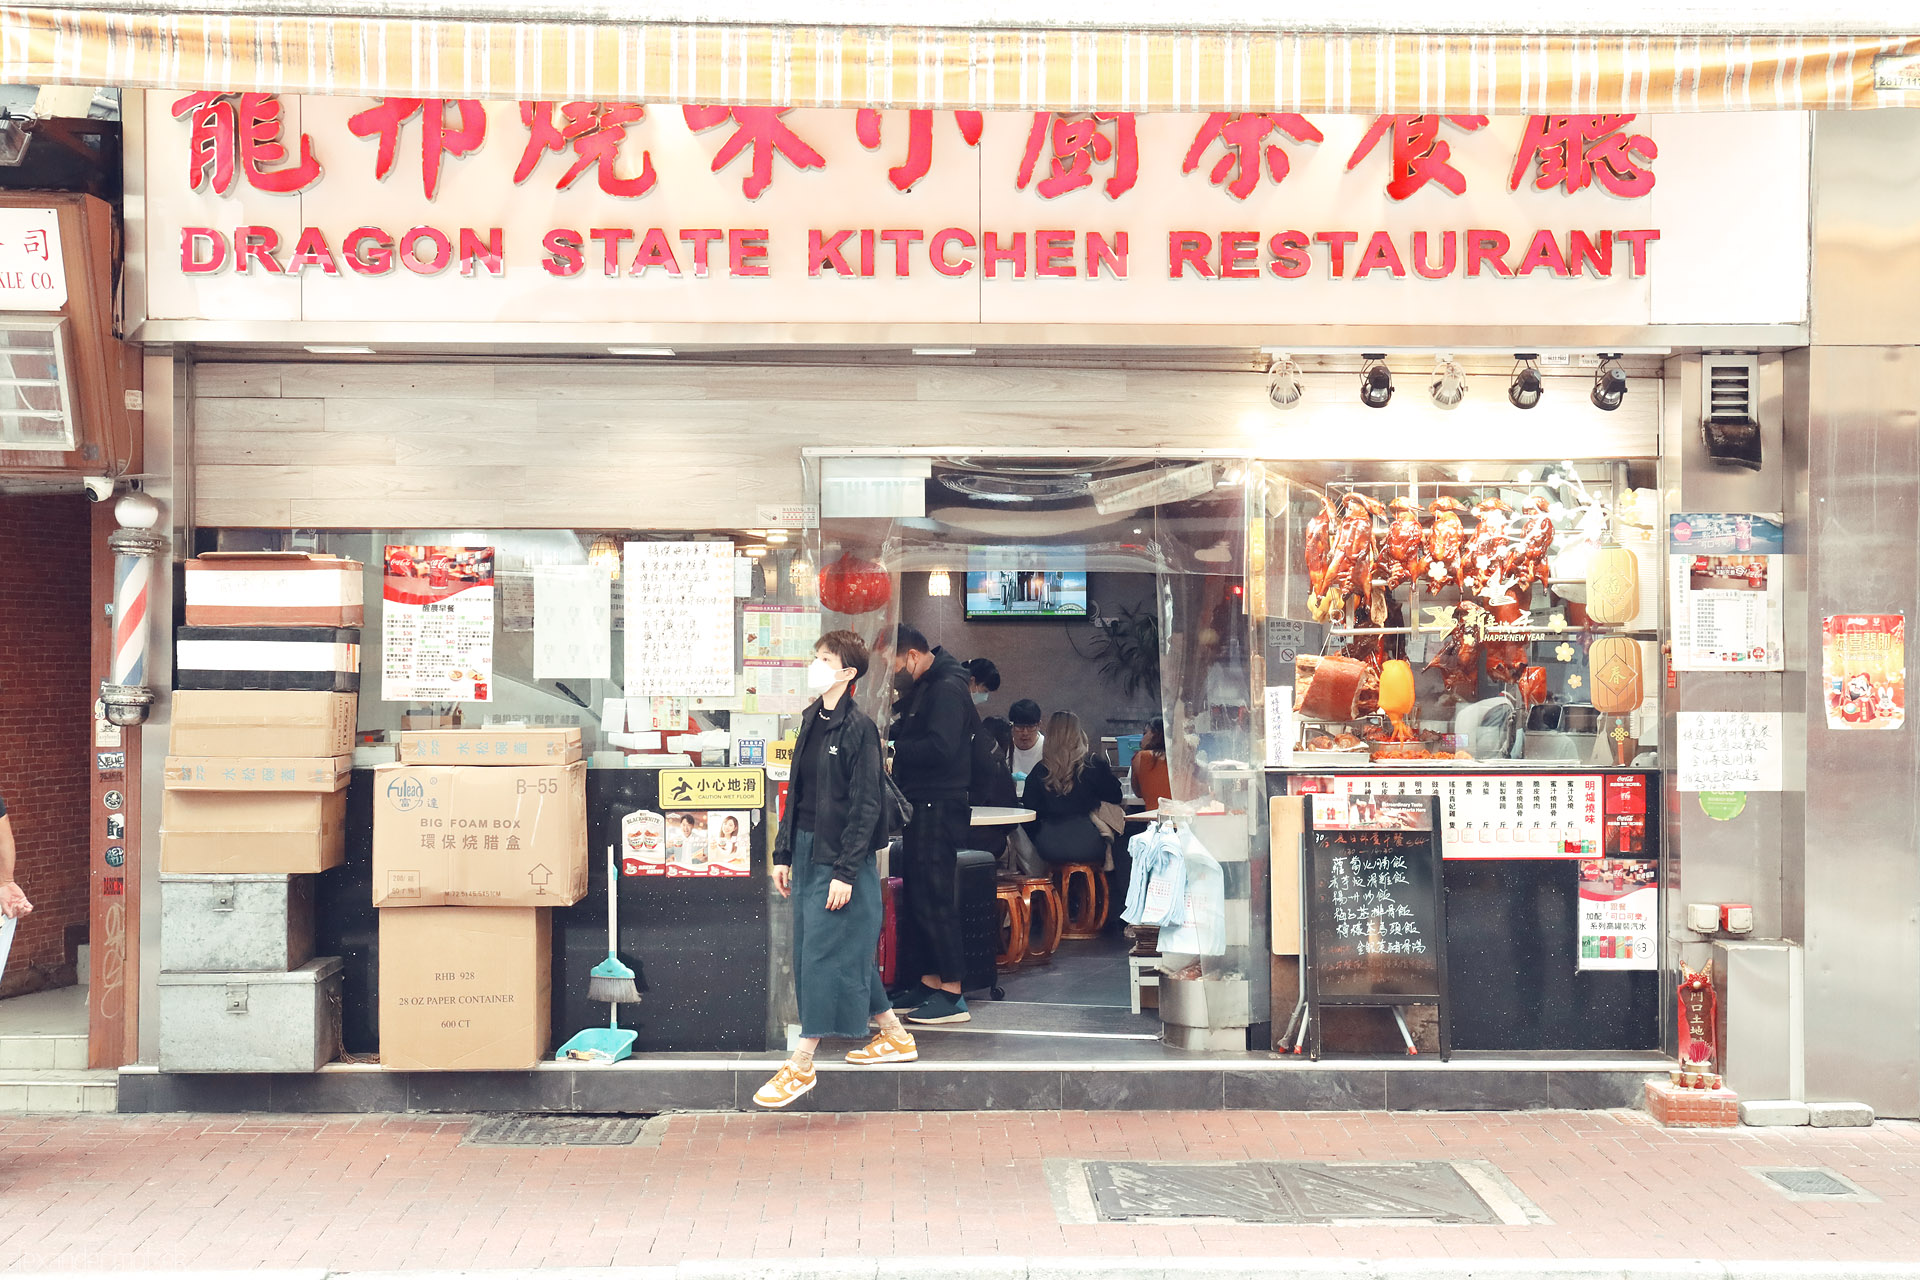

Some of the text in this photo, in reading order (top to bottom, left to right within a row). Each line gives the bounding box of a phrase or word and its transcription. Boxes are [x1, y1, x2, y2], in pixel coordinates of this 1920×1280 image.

[180, 224, 1661, 281] DRAGON STATE KITCHEN RESTAURANT
[31, 271, 55, 290] CO.
[1510, 634, 1526, 642] NEW
[1527, 633, 1546, 641] YEAR
[1608, 665, 1627, 685] 春
[515, 777, 559, 795] B-55
[697, 777, 757, 793] 小心地滑
[1584, 780, 1596, 824] 明爐燒味
[420, 817, 521, 829] BIG FOAM BOX
[420, 833, 521, 851] 環保烧腊盒
[535, 885, 547, 896] 上
[434, 971, 476, 981] RHB 928
[399, 994, 515, 1006] 28 OZ PAPER CONTAINER
[441, 1019, 471, 1029] 600 CT
